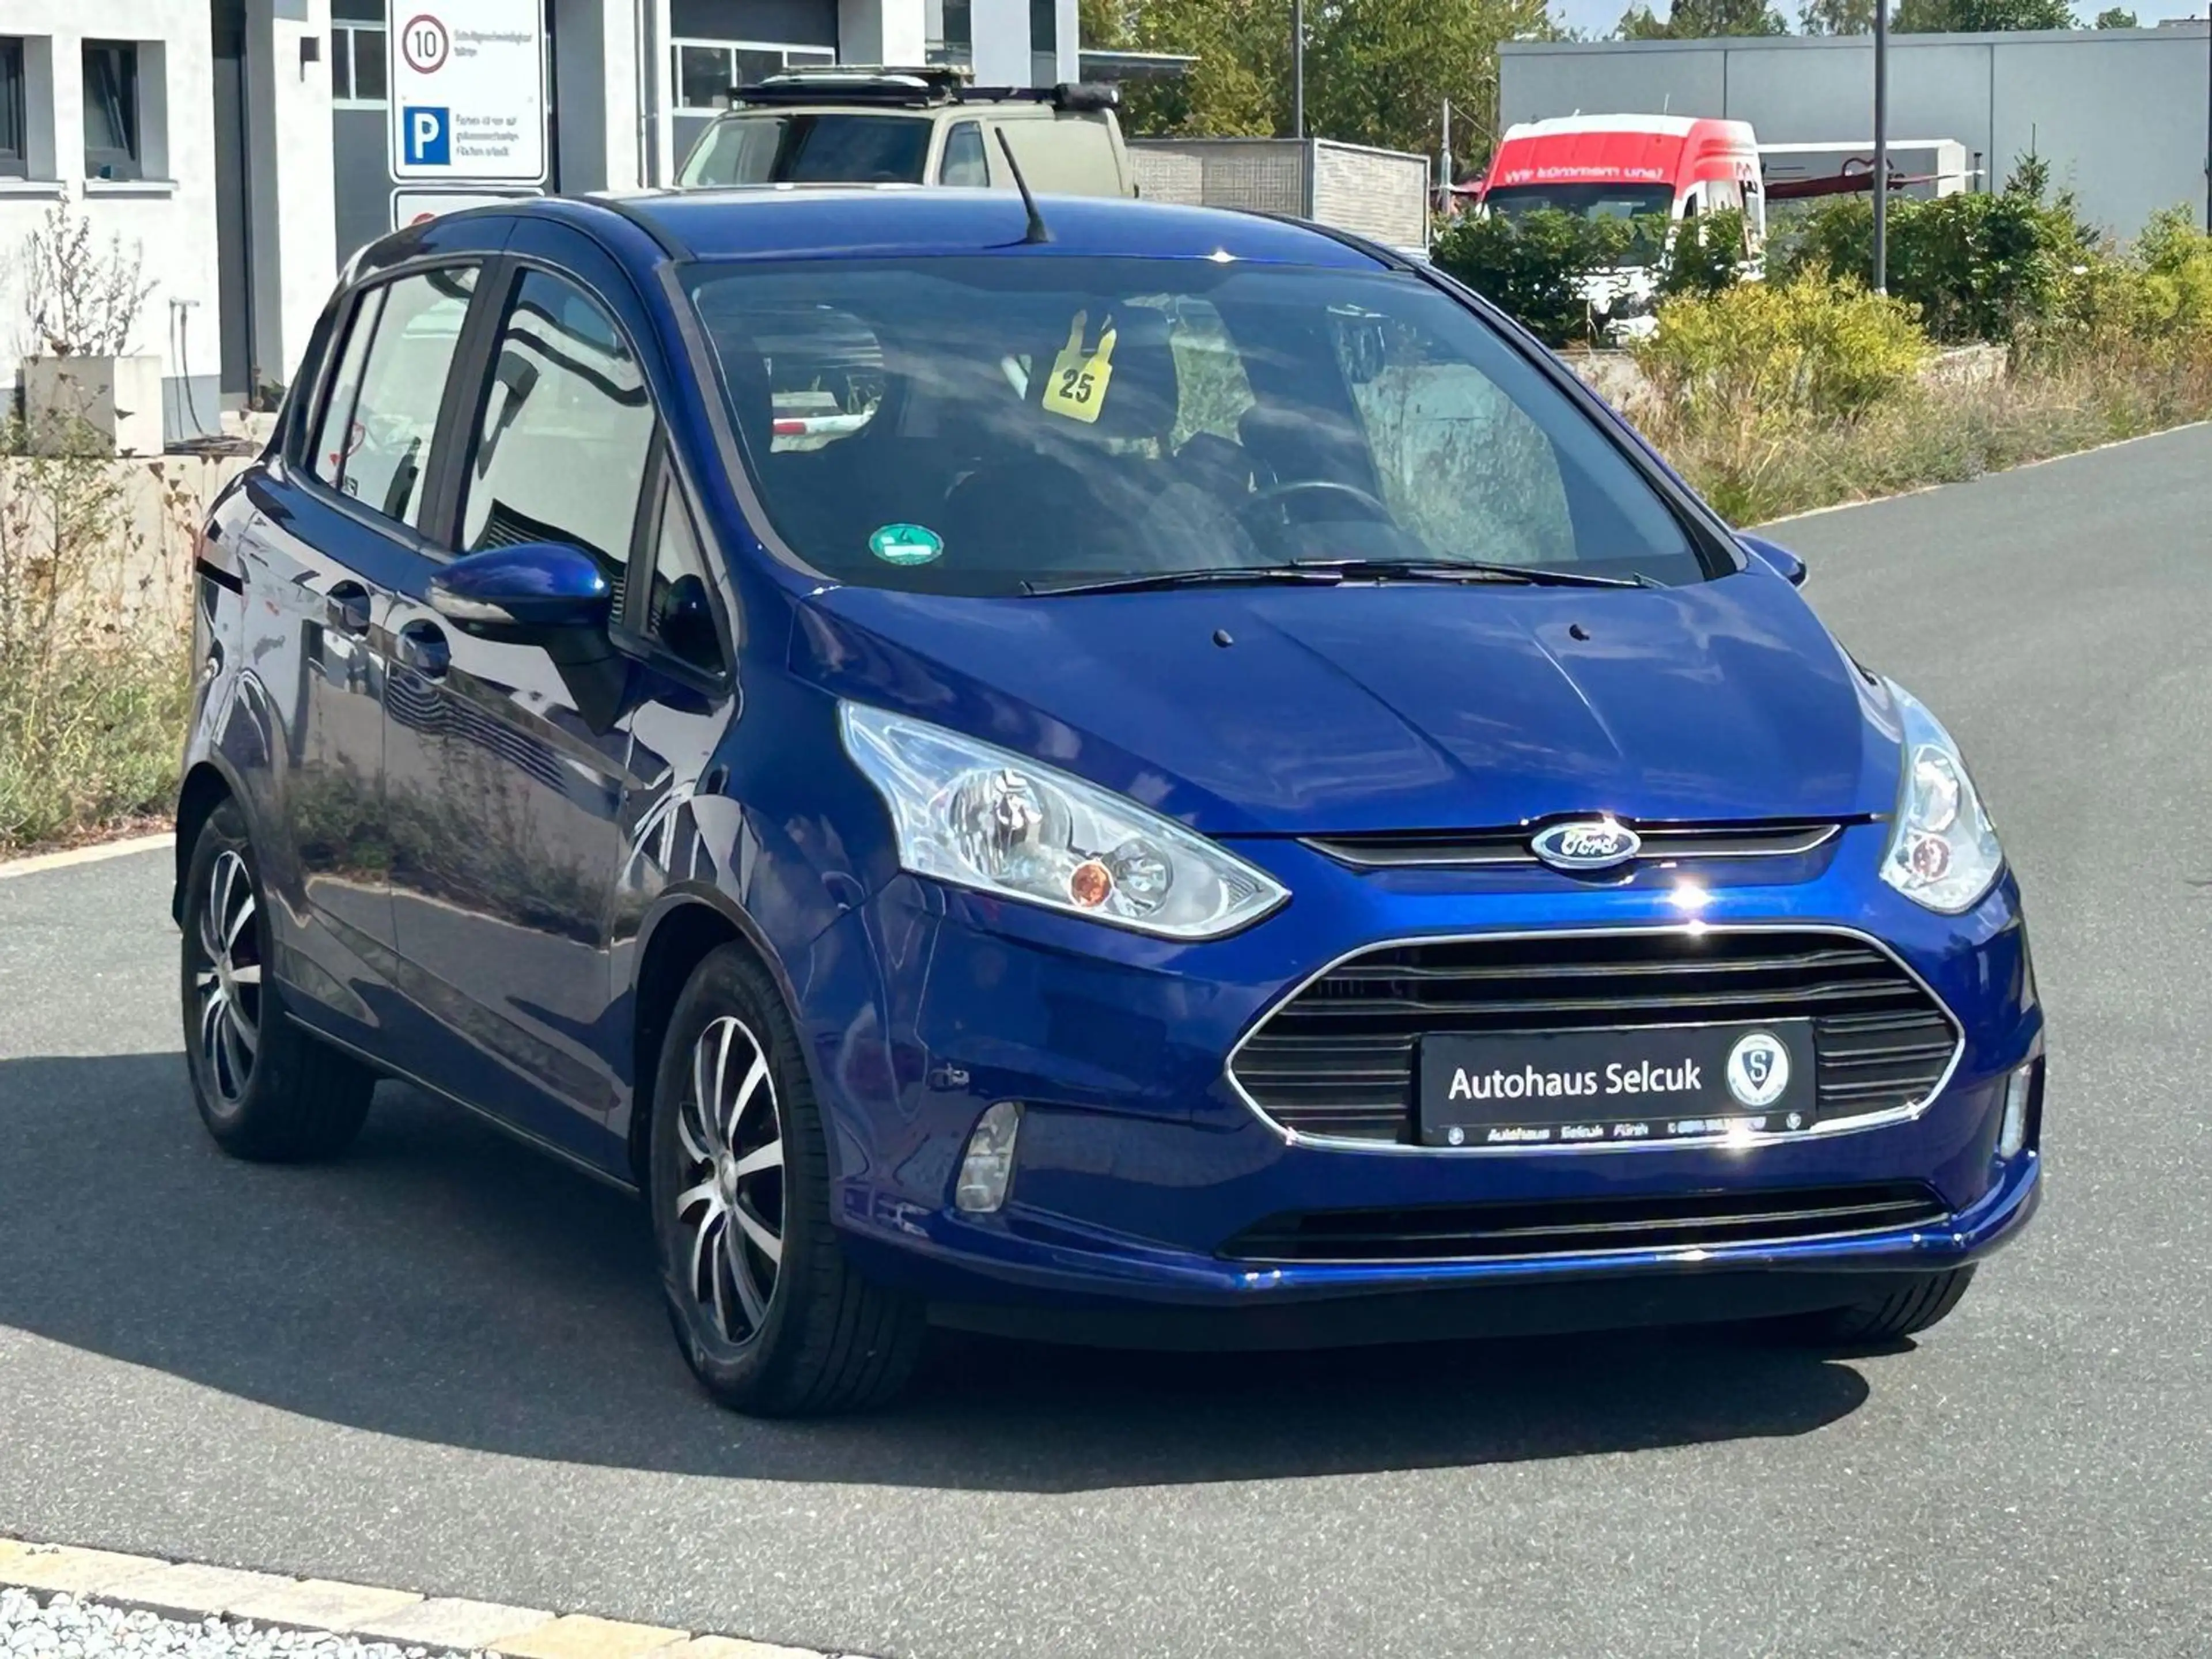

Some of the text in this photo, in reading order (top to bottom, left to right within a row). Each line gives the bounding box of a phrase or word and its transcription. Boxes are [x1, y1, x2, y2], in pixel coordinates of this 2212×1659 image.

[414, 30, 437, 58] 10
[414, 112, 440, 159] P
[1059, 369, 1095, 403] 25
[1560, 828, 1619, 855] Ford
[1448, 1065, 1598, 1100] Autohaus
[1605, 1058, 1702, 1094] Selcuk
[1749, 1051, 1767, 1082] S
